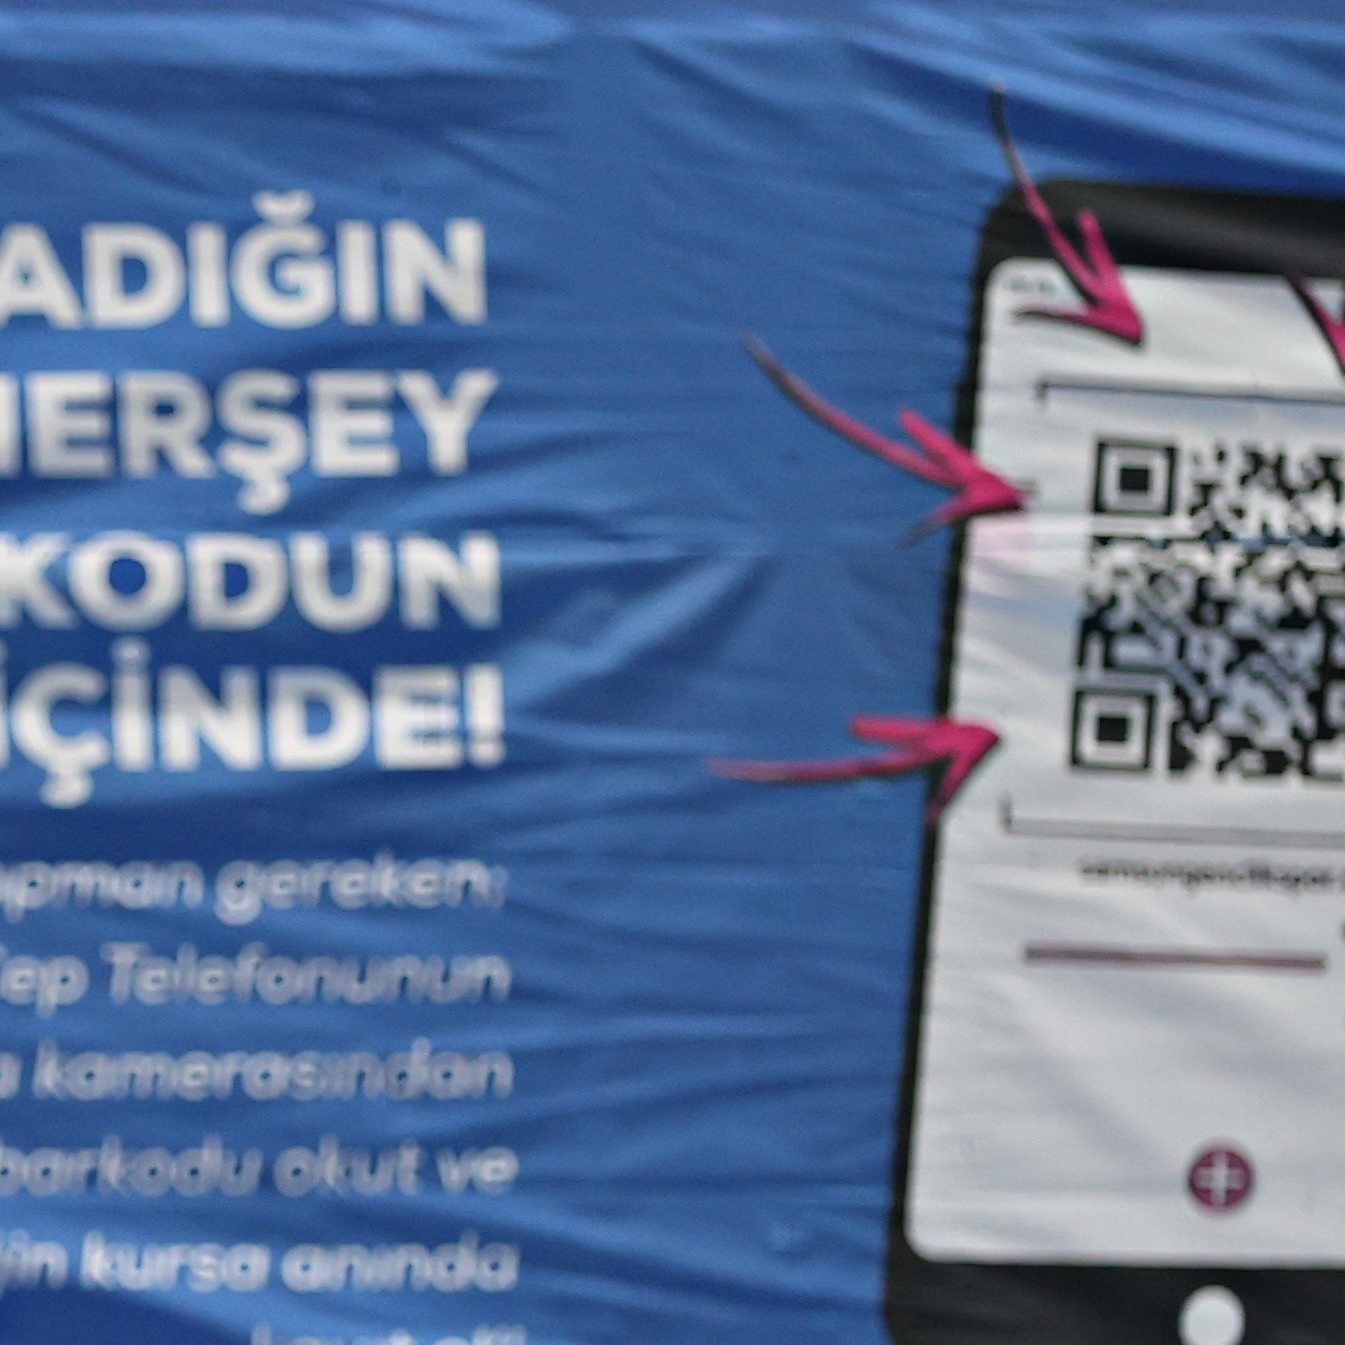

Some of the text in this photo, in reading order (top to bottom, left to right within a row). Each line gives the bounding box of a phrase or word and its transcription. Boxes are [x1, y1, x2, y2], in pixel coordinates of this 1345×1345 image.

[101, 942, 510, 1006] Telefonunun
[32, 1037, 514, 1101] kamerasından
[272, 1135, 422, 1197] okut
[436, 1147, 519, 1197] ve
[80, 1230, 270, 1293] kursa
